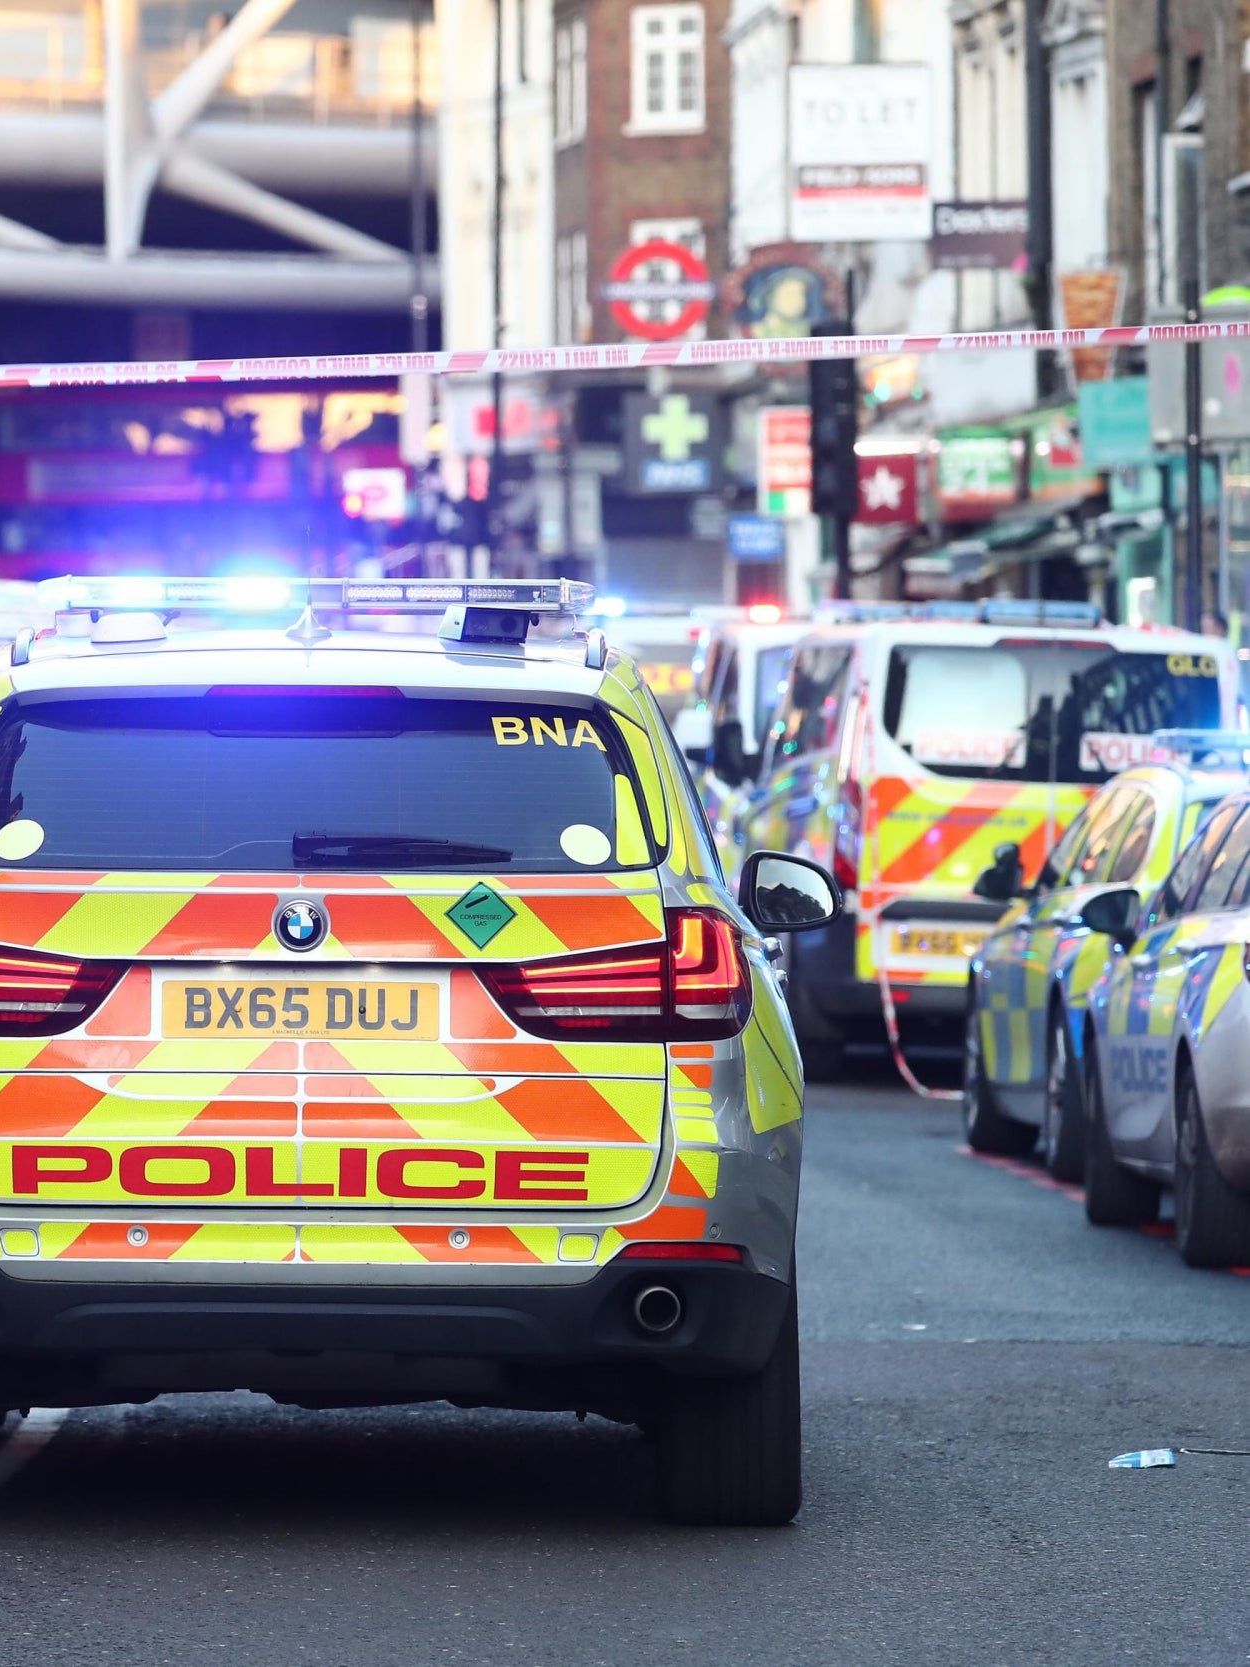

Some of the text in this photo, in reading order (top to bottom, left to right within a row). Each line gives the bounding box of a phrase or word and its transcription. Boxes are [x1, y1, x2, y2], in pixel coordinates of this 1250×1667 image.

[804, 100, 916, 124] TO LET
[491, 717, 608, 752] BNA
[459, 913, 502, 921] COMPRESSED
[184, 987, 419, 1031] BX65 DUJ
[11, 1144, 590, 1200] POLICE
